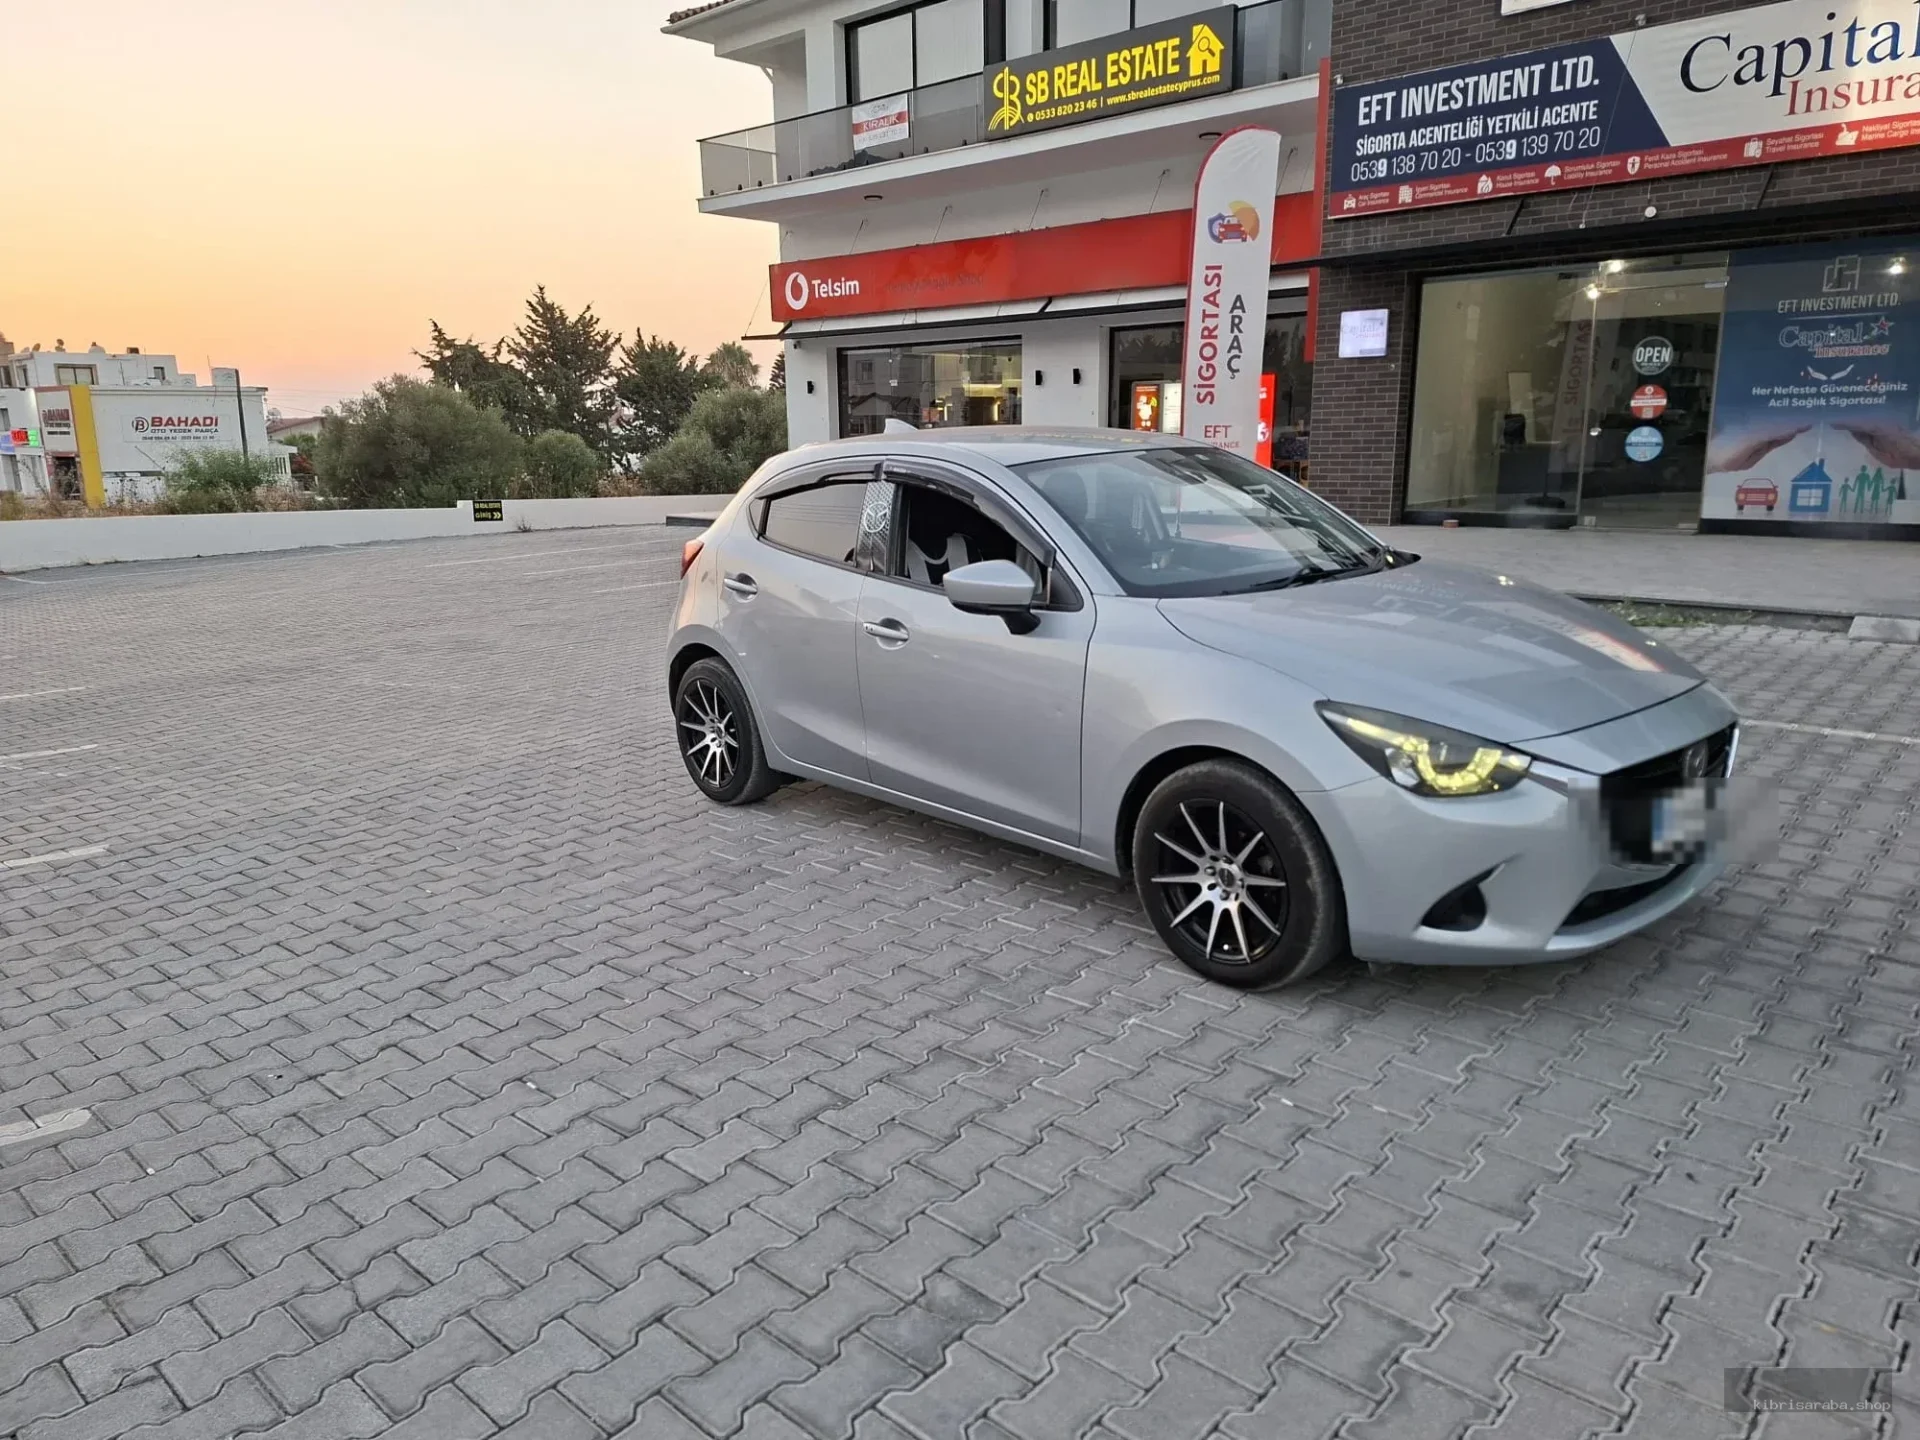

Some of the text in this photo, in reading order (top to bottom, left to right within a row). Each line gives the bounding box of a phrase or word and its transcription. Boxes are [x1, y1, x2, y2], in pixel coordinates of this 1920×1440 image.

[1026, 37, 1180, 106] SB REAL ESTATE
[1035, 108, 1056, 121] 0533
[1057, 104, 1073, 117] 820
[1074, 102, 1085, 113] 23
[1086, 99, 1098, 110] 46
[1106, 74, 1220, 106] www.sbrealestatecyprus.com
[1358, 55, 1600, 126] EFT INVESTMENT LTD.
[863, 114, 899, 131] KIRALIK
[1356, 100, 1599, 157] SİGORTA ACENTELİĞİ YETKİLİ ACENTE
[1351, 158, 1387, 182] 0539
[1392, 154, 1415, 175] 138
[1419, 151, 1437, 172] 70
[1442, 147, 1460, 167] 20
[1475, 139, 1517, 163] 0539
[1522, 134, 1549, 157] 139
[1554, 130, 1574, 152] 70
[1578, 126, 1601, 149] 20
[811, 276, 860, 299] Telsim
[1778, 292, 1902, 314] EFT INVESTMENT LTD.
[1194, 264, 1224, 405] SİGORTASI
[1226, 294, 1246, 380] ARAÇ
[1779, 321, 1864, 350] Capital
[1636, 347, 1670, 363] OPEN
[1814, 344, 1890, 358] Insurance
[1752, 382, 1908, 396] Her Nefeste Güveneceğiniz
[1768, 396, 1790, 408] Acil
[1791, 396, 1826, 408] Sağlık
[1204, 425, 1232, 438] EFT
